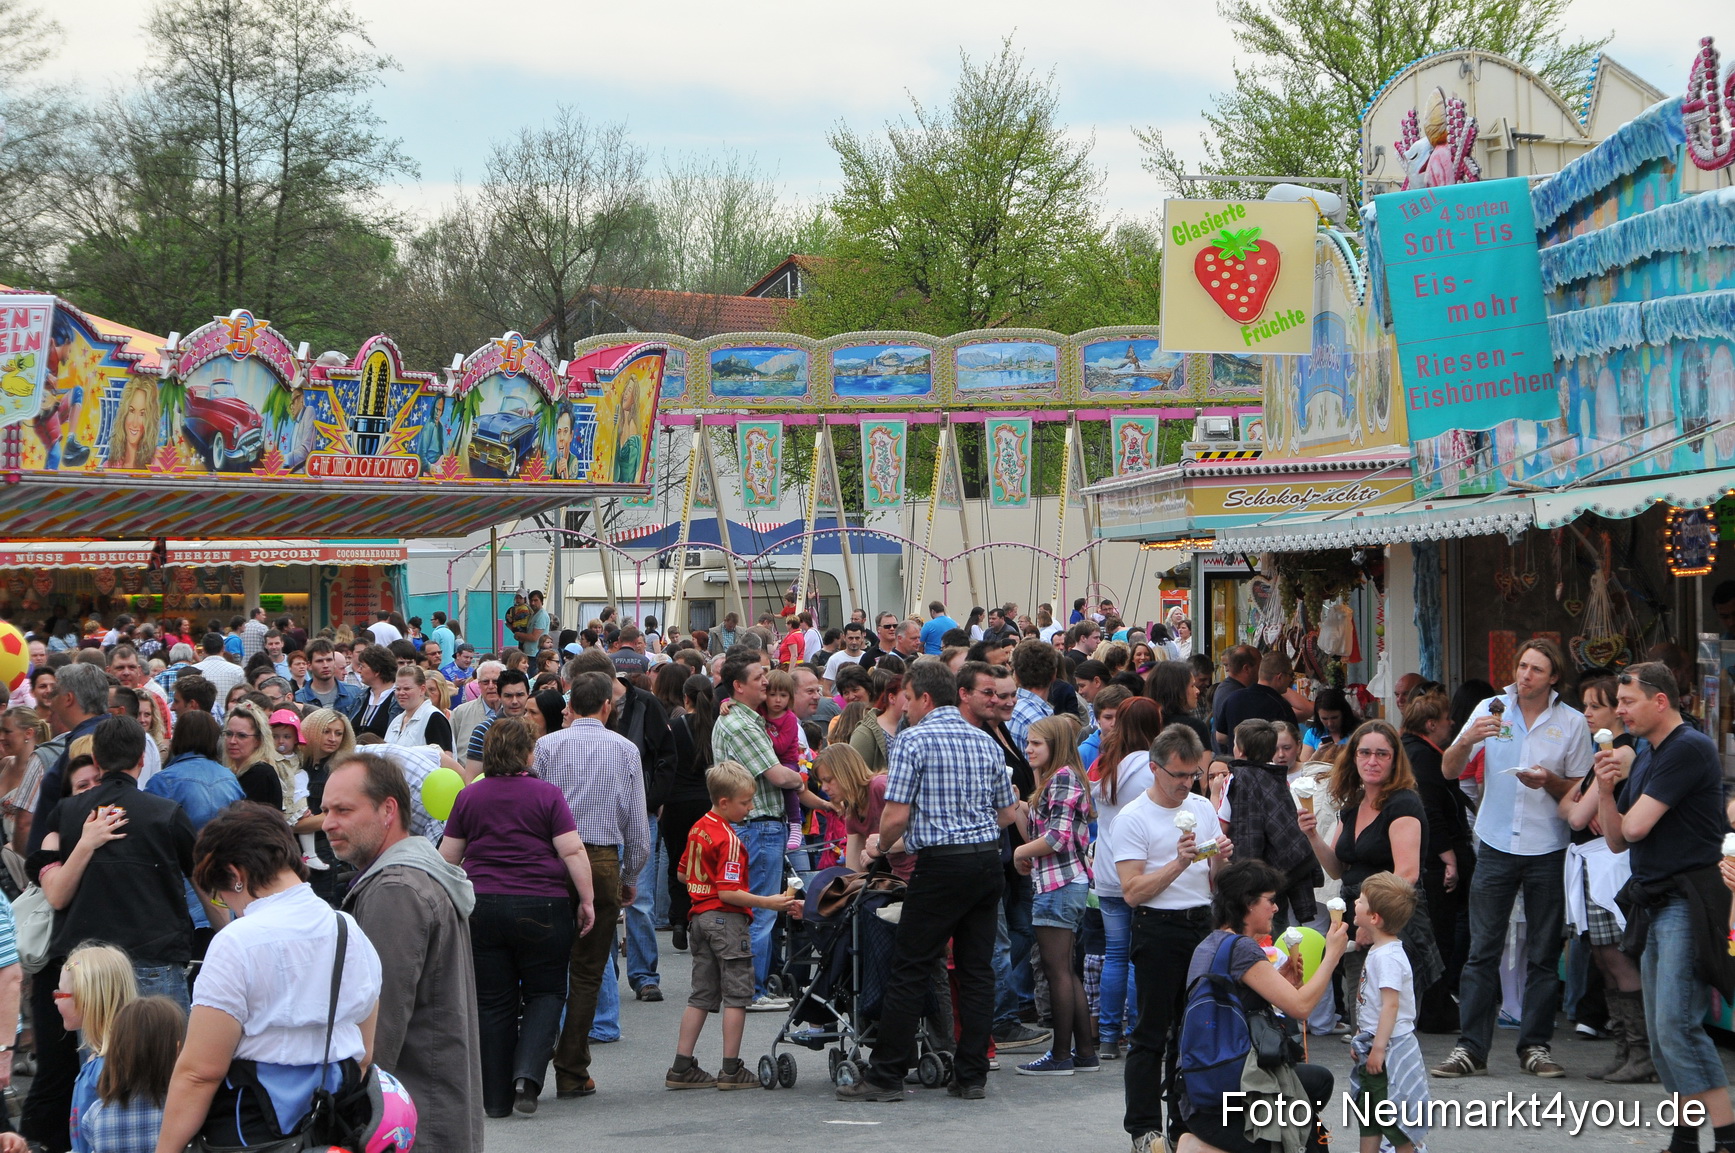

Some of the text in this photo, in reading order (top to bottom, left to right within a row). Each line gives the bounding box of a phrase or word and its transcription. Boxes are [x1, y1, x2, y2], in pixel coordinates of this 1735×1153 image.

[1172, 203, 1247, 246] Glasierte
[1440, 200, 1510, 222] 4 Sorten
[1447, 294, 1519, 323] mohr
[1240, 309, 1306, 347] Früchte
[1408, 371, 1555, 411] Eishörnchen
[320, 457, 330, 475] THE
[359, 458, 372, 476] OF
[373, 458, 389, 477] HOT
[15, 552, 64, 562] NÜSSE
[250, 549, 321, 559] POPCORN
[336, 549, 401, 558] COCOSMAKRONEN
